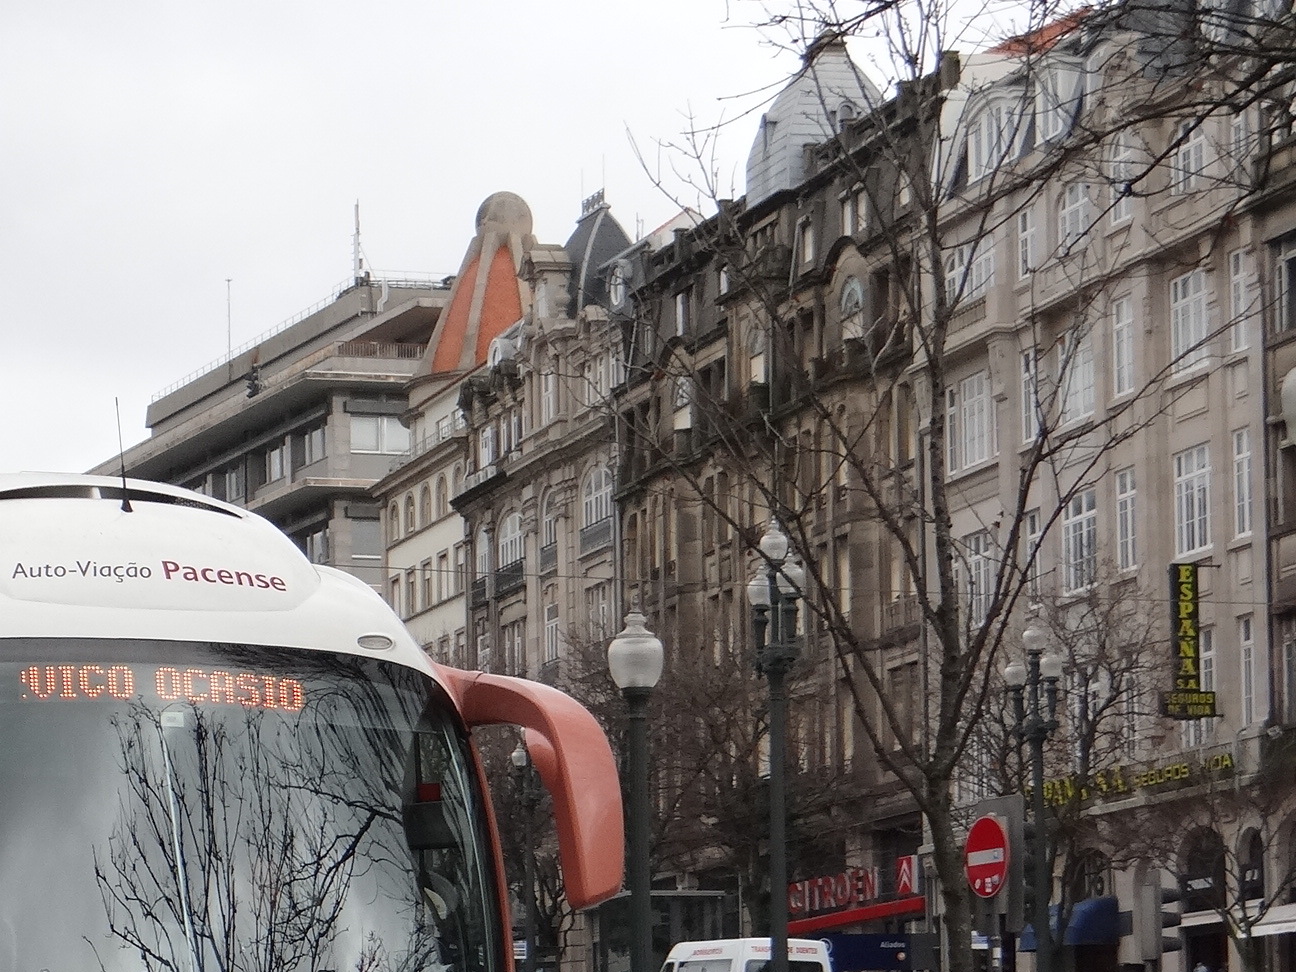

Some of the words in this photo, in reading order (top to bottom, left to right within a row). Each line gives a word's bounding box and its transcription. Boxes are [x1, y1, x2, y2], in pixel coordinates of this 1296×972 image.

[12, 560, 152, 584] Auto-Viação
[161, 560, 287, 592] Pacense
[1178, 565, 1197, 675] ESPAÑA
[20, 663, 134, 699] VICO
[155, 666, 303, 711] OCASIO
